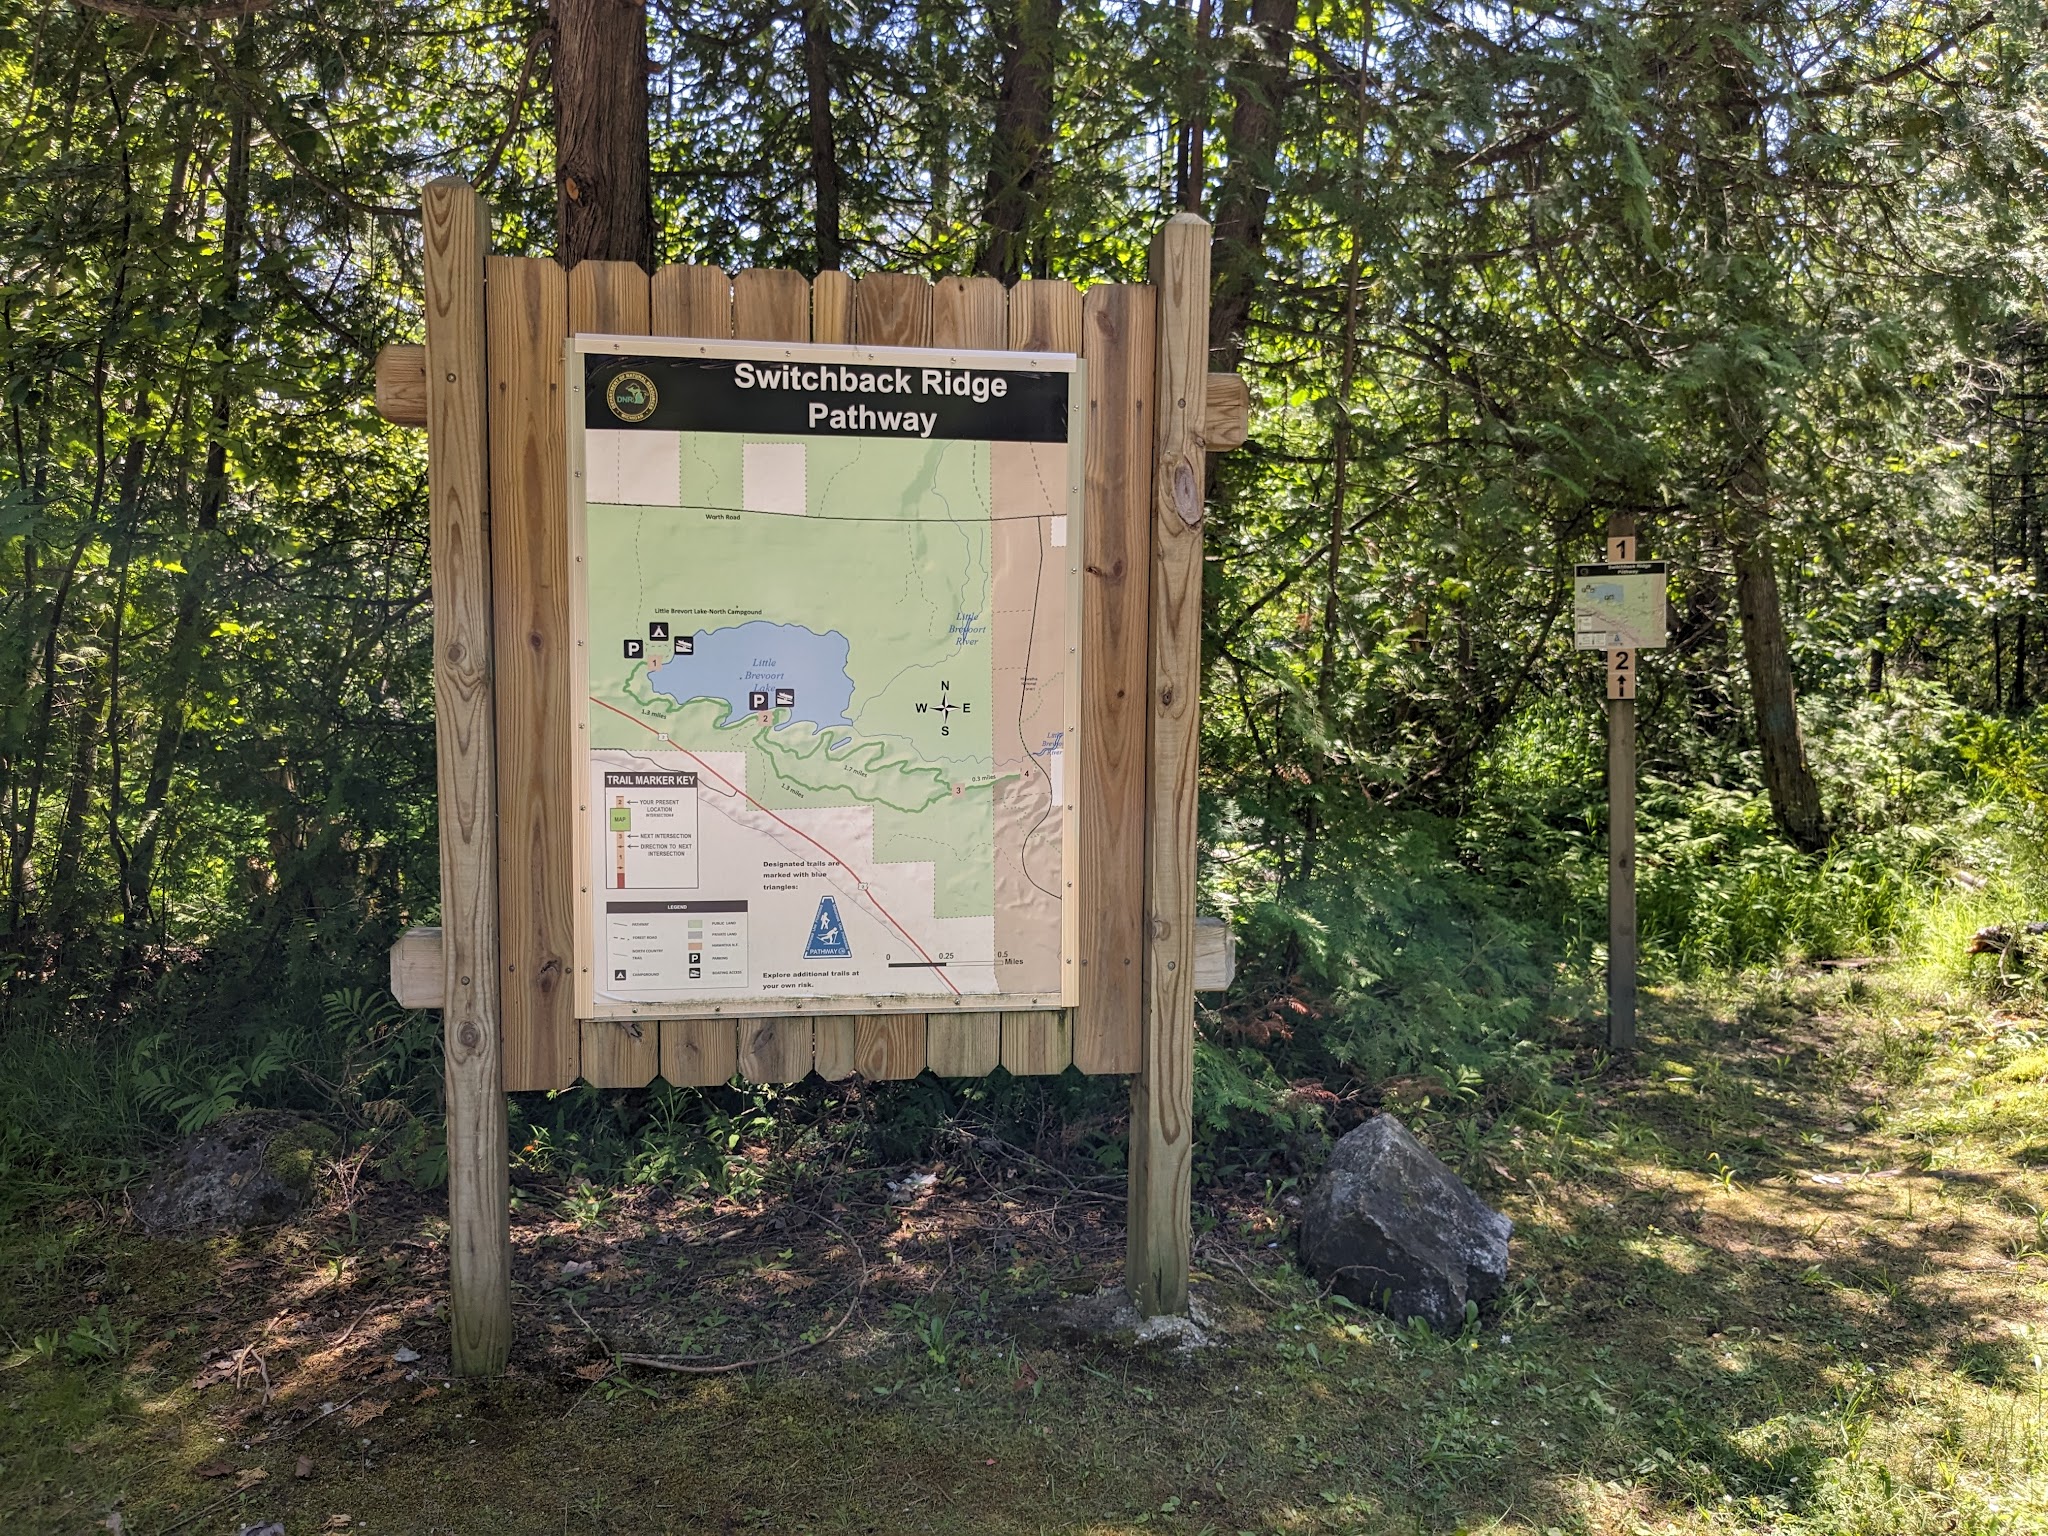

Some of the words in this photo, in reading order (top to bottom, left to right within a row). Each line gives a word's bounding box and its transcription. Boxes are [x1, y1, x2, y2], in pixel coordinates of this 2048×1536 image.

[734, 363, 912, 394] Switchback
[921, 369, 1008, 403] Ridge
[808, 402, 938, 438] Pathway
[1616, 540, 1626, 559] 1
[956, 612, 979, 621] Little
[948, 624, 987, 634] Brevoort
[955, 637, 979, 646] River
[628, 642, 640, 656] P
[752, 658, 777, 667] Little
[1616, 651, 1629, 670] 2
[744, 671, 785, 680] Brevoort
[753, 683, 776, 693] Lake
[941, 680, 950, 691] N
[753, 694, 765, 708] P
[915, 702, 928, 713] W
[963, 702, 971, 713] E
[651, 711, 667, 720] miles
[941, 725, 950, 736] S
[843, 764, 853, 772] 1.7
[852, 768, 868, 778] miles
[606, 775, 634, 785] TRAIL
[635, 775, 675, 785] MARKER
[676, 775, 696, 785] KEY
[789, 787, 805, 799] miles
[691, 954, 699, 963] P
[938, 952, 955, 960] 0.25
